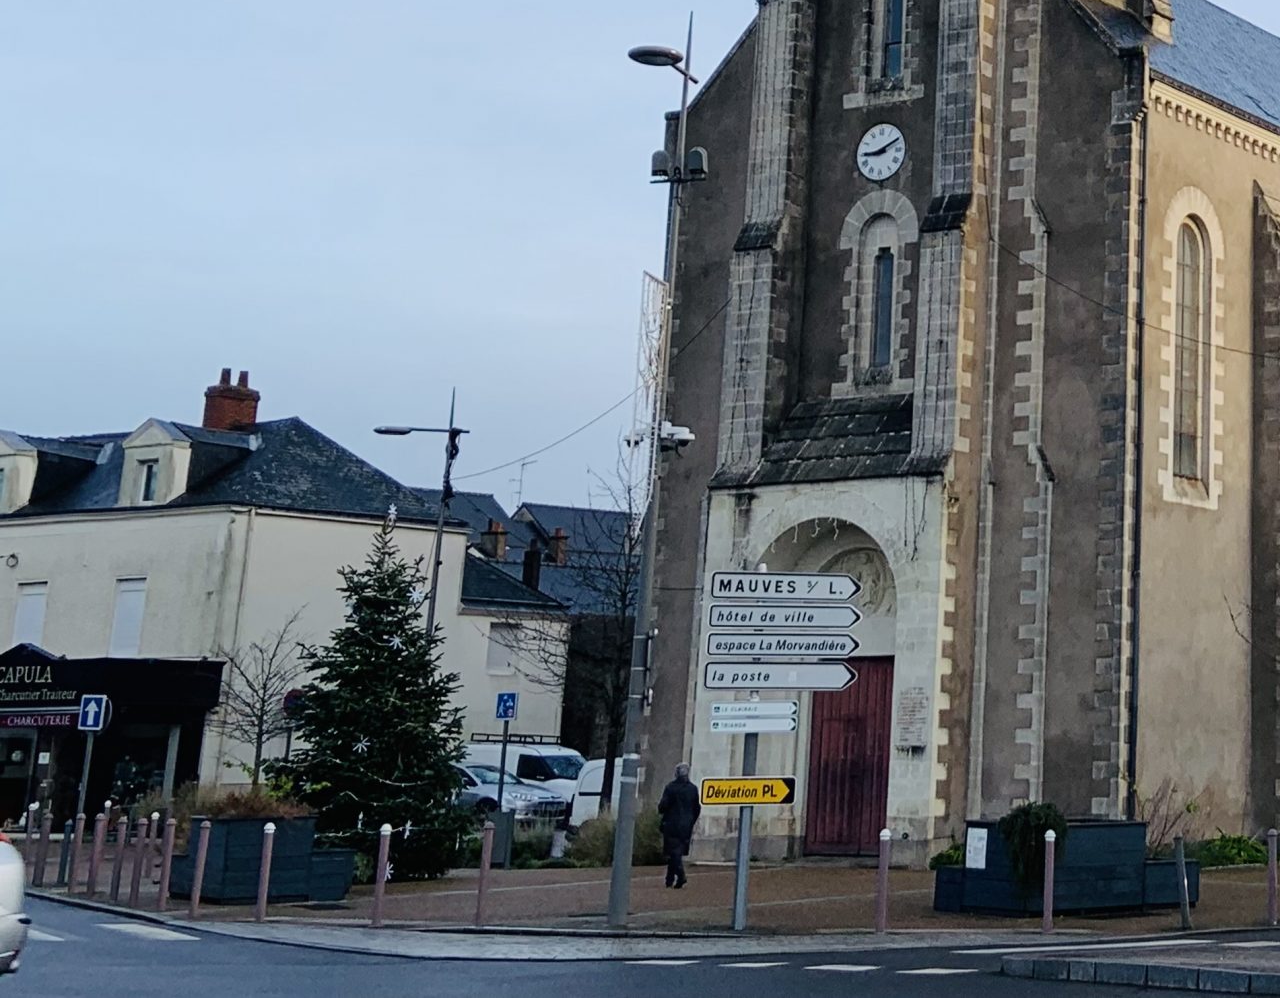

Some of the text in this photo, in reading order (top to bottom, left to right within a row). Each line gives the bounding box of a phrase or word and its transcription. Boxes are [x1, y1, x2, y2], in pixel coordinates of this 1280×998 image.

[718, 579, 797, 594] MAUVES
[829, 581, 843, 595] L.
[716, 610, 815, 623] hôtel de ville
[715, 639, 846, 653] espace La Morvandière
[712, 670, 771, 684] la poste
[7, 715, 71, 727] CHARCUTERIE
[706, 784, 778, 799] Déviation PL
